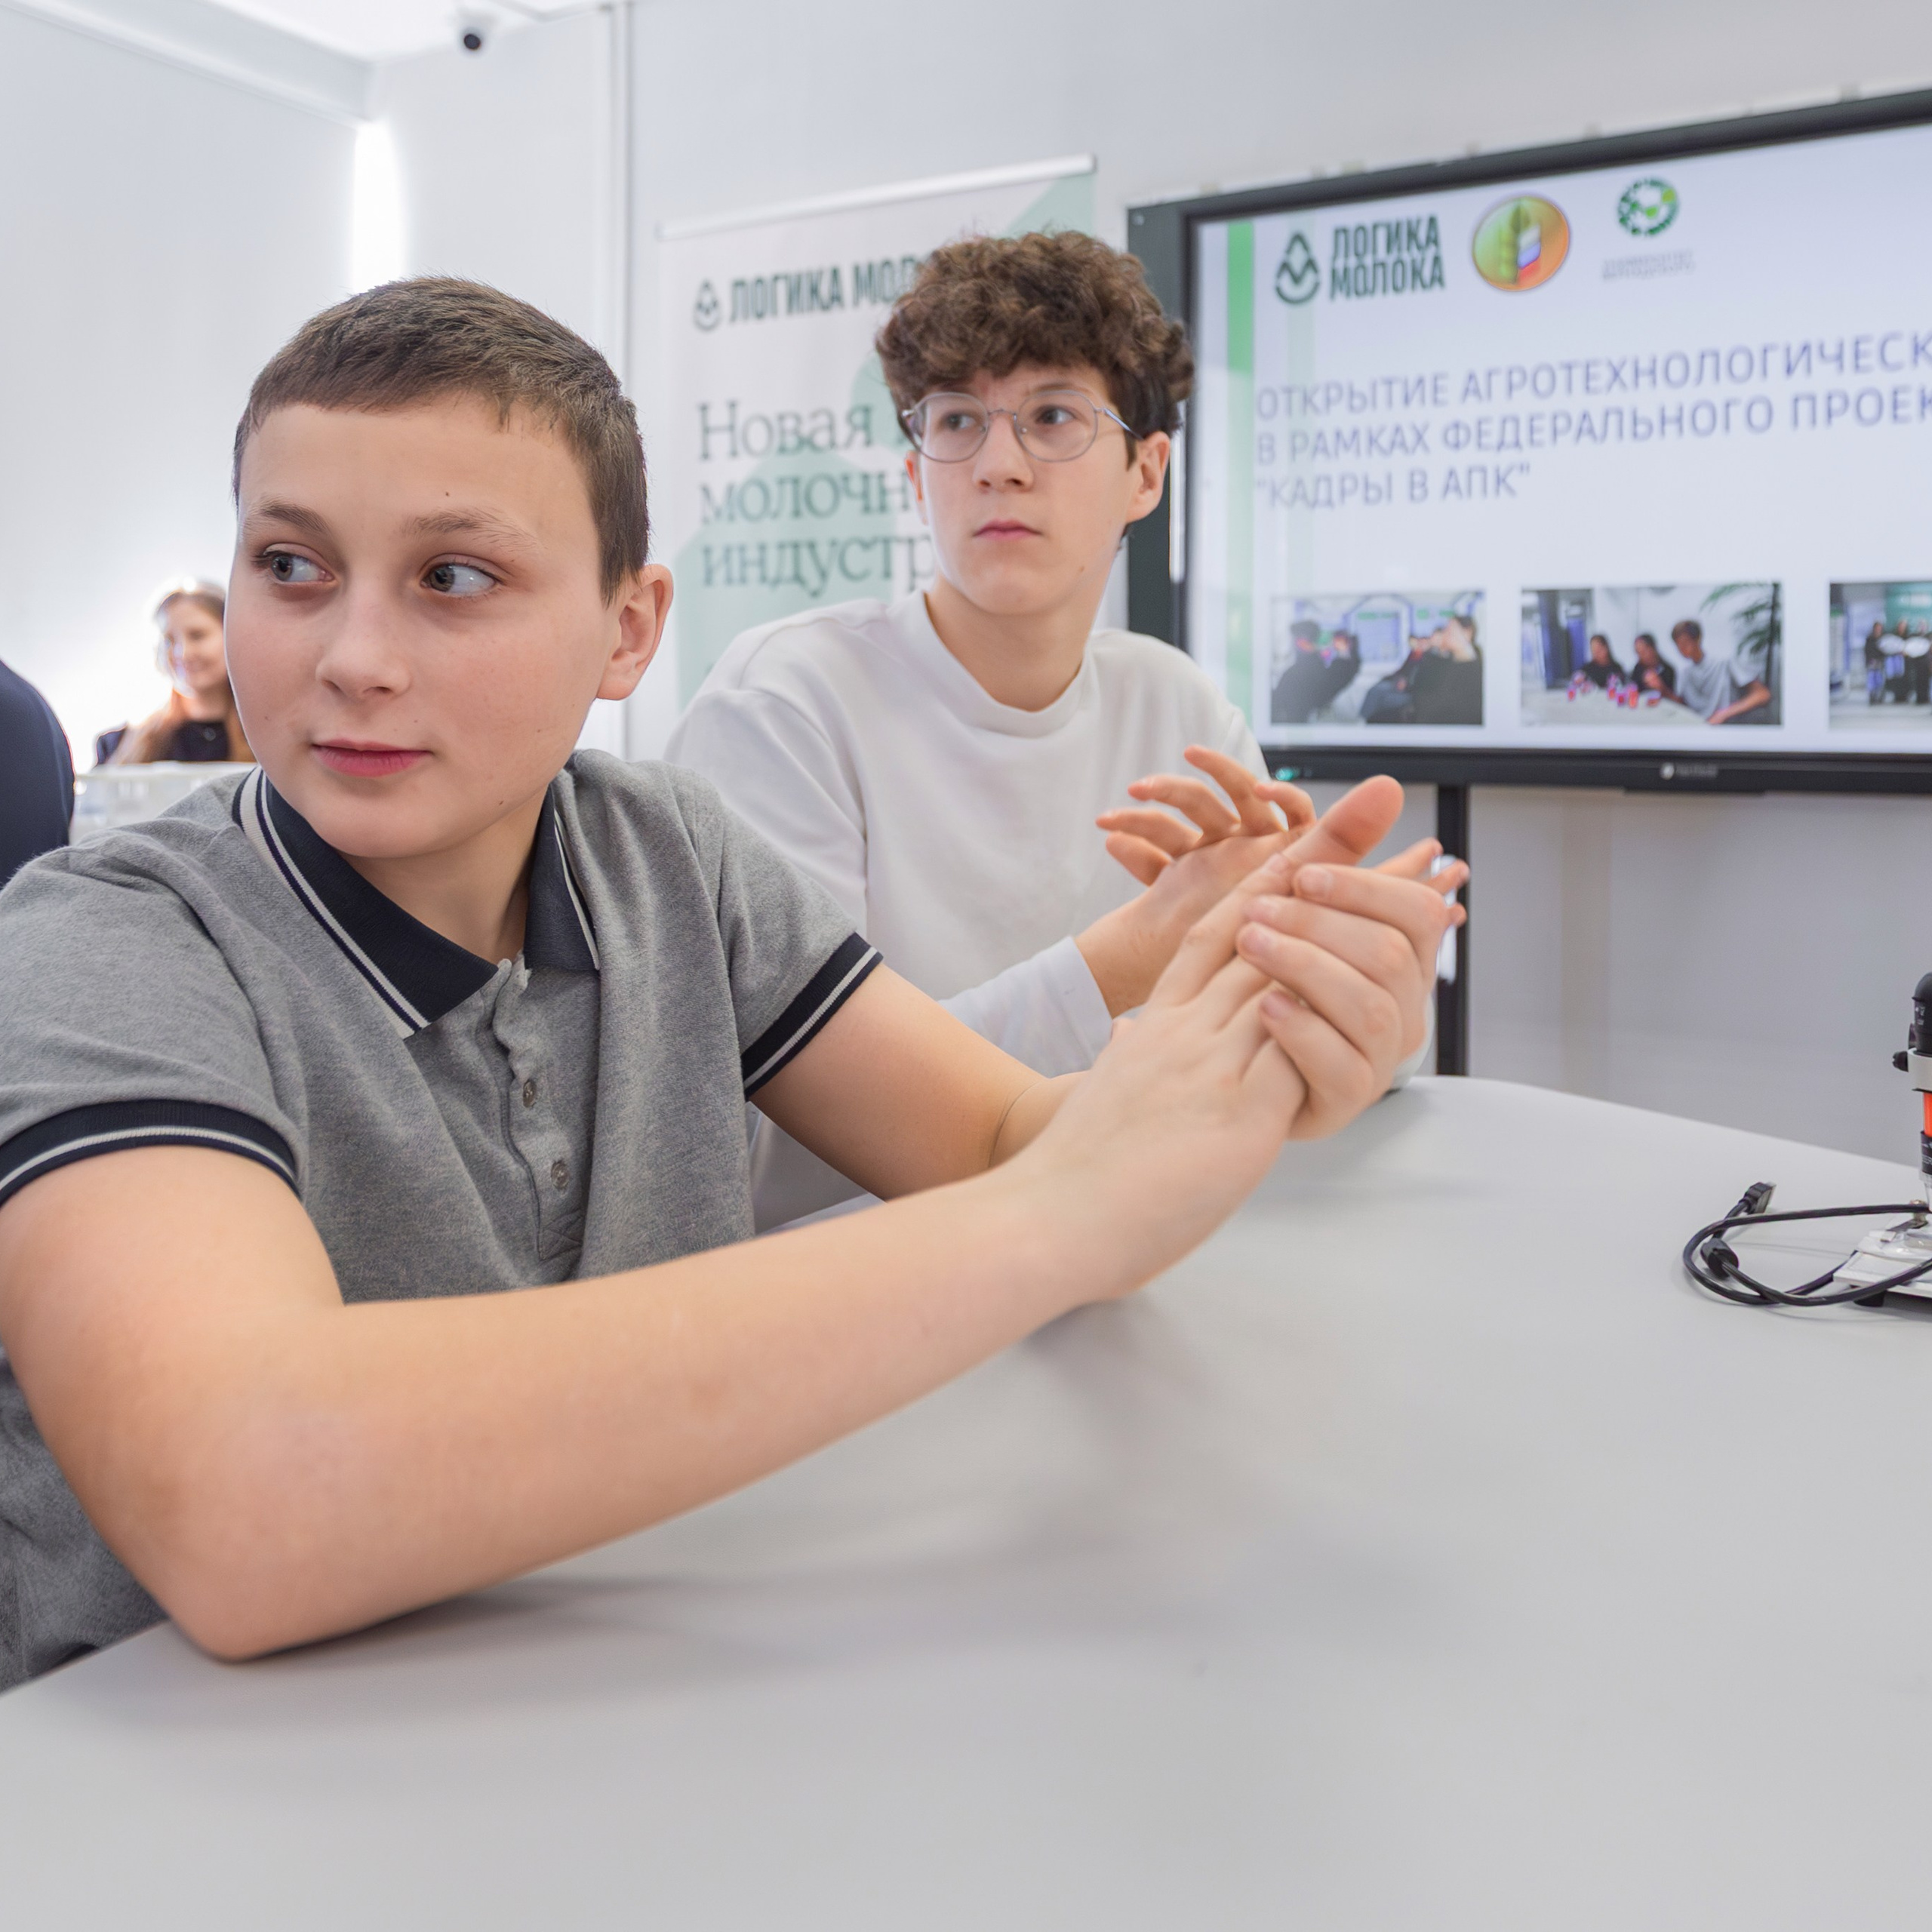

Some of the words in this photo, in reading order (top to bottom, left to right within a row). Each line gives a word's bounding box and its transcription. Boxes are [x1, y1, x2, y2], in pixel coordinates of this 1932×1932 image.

[1334, 214, 1441, 260] ЛОГИКА
[729, 266, 845, 325] ЛОГИКА
[853, 255, 918, 306] МОЛ
[1330, 255, 1444, 300] МОЛОКА
[1256, 372, 1451, 421] ОТКРЫТИЕ
[1461, 331, 1932, 403] АГРОТЕХНОЛОГИЧЕСК
[697, 398, 873, 462] Новая
[1257, 432, 1277, 466] В
[1291, 420, 1430, 463] РАМКАХ
[1442, 394, 1775, 454] ФЕДЕРАЛЬНОГО
[1257, 470, 1393, 510] "КАДРЫ
[1409, 468, 1429, 504] В
[1441, 461, 1531, 501] АПК"
